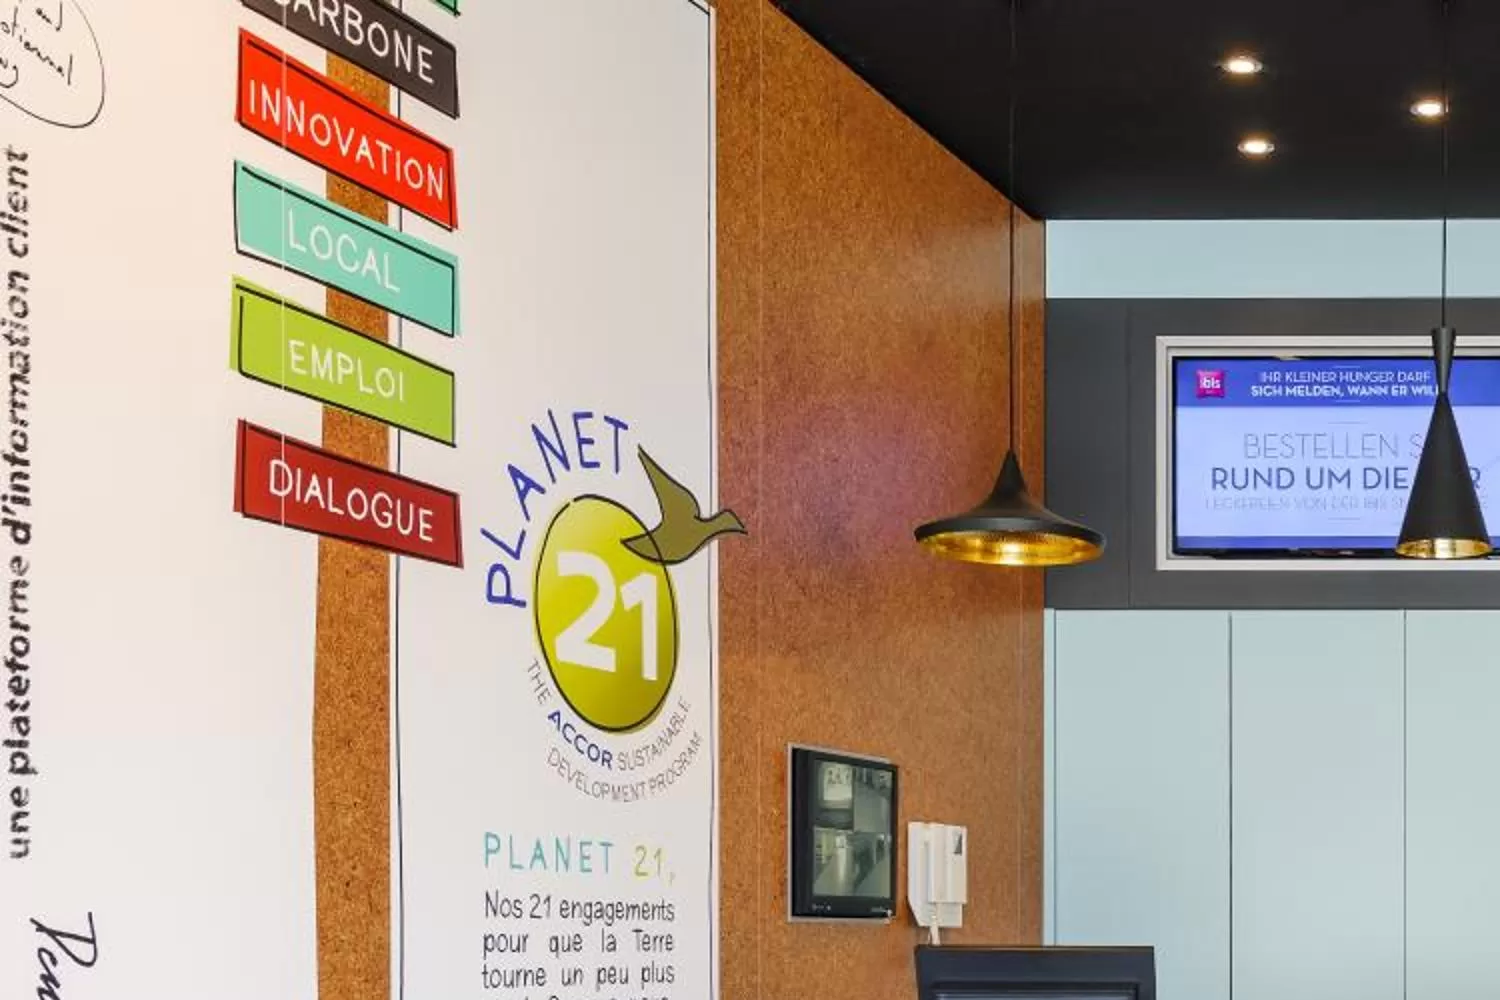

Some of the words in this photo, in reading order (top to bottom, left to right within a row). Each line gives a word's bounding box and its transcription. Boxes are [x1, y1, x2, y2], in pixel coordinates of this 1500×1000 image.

[273, 0, 434, 84] ARBONE
[249, 79, 445, 201] INNOVATION
[0, 143, 30, 260] client
[288, 210, 401, 292] LOCAL
[288, 339, 405, 401] EMPLOI
[1250, 385, 1284, 397] SICH
[1287, 385, 1344, 399] MELDEN,
[1349, 385, 1388, 397] WANN
[1391, 385, 1409, 397] ER
[1285, 371, 1336, 383] KLEINER
[1340, 371, 1395, 383] HUNGER
[1397, 371, 1432, 383] DARF
[1, 270, 32, 546] d'information
[1243, 432, 1400, 459] BESTELLEN
[268, 459, 434, 542] DIALOGUE
[480, 408, 629, 609] PLANET
[1211, 467, 1295, 490] RUND
[1305, 467, 1351, 490] UM
[1362, 467, 1409, 490] DIE
[555, 551, 658, 681] 21
[2, 555, 38, 776] plateforme
[527, 657, 551, 705] THE
[547, 709, 614, 771] ACCOR
[616, 696, 692, 772] SUSTAINABLE
[546, 746, 646, 803] DEVELOPMENT
[9, 785, 32, 860] une
[483, 831, 615, 874] PLANET
[483, 932, 529, 960] pour
[549, 932, 583, 959] que
[601, 928, 617, 953] la
[632, 929, 673, 953] Terre
[484, 889, 523, 919] Nos
[529, 893, 551, 919] 21
[559, 899, 675, 927] engagements
[481, 964, 547, 989] tourne
[561, 967, 583, 987] un
[596, 965, 629, 992] peu
[640, 961, 675, 990] plus
